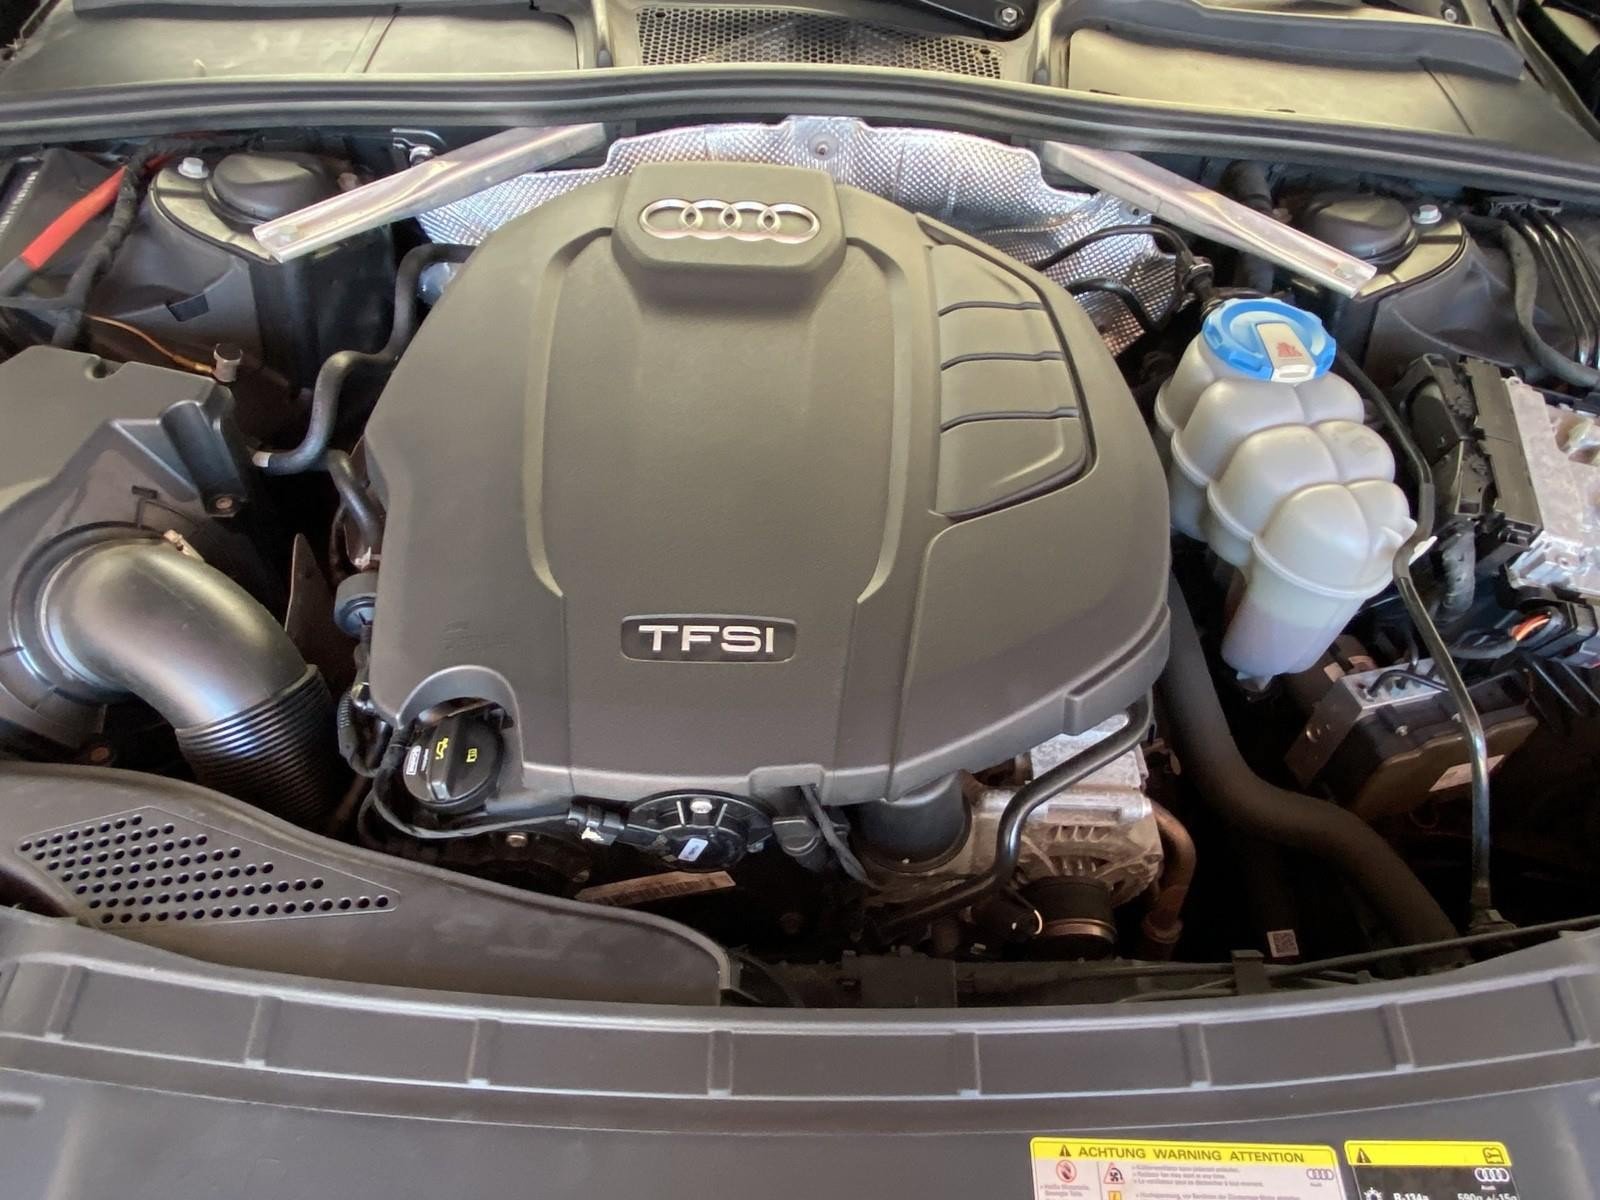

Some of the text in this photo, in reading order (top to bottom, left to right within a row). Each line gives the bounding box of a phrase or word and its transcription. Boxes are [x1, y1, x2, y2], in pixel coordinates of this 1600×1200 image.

[638, 625, 774, 653] TFSI
[1078, 1146, 1305, 1163] ACHTUNG WARNING ATTENTION
